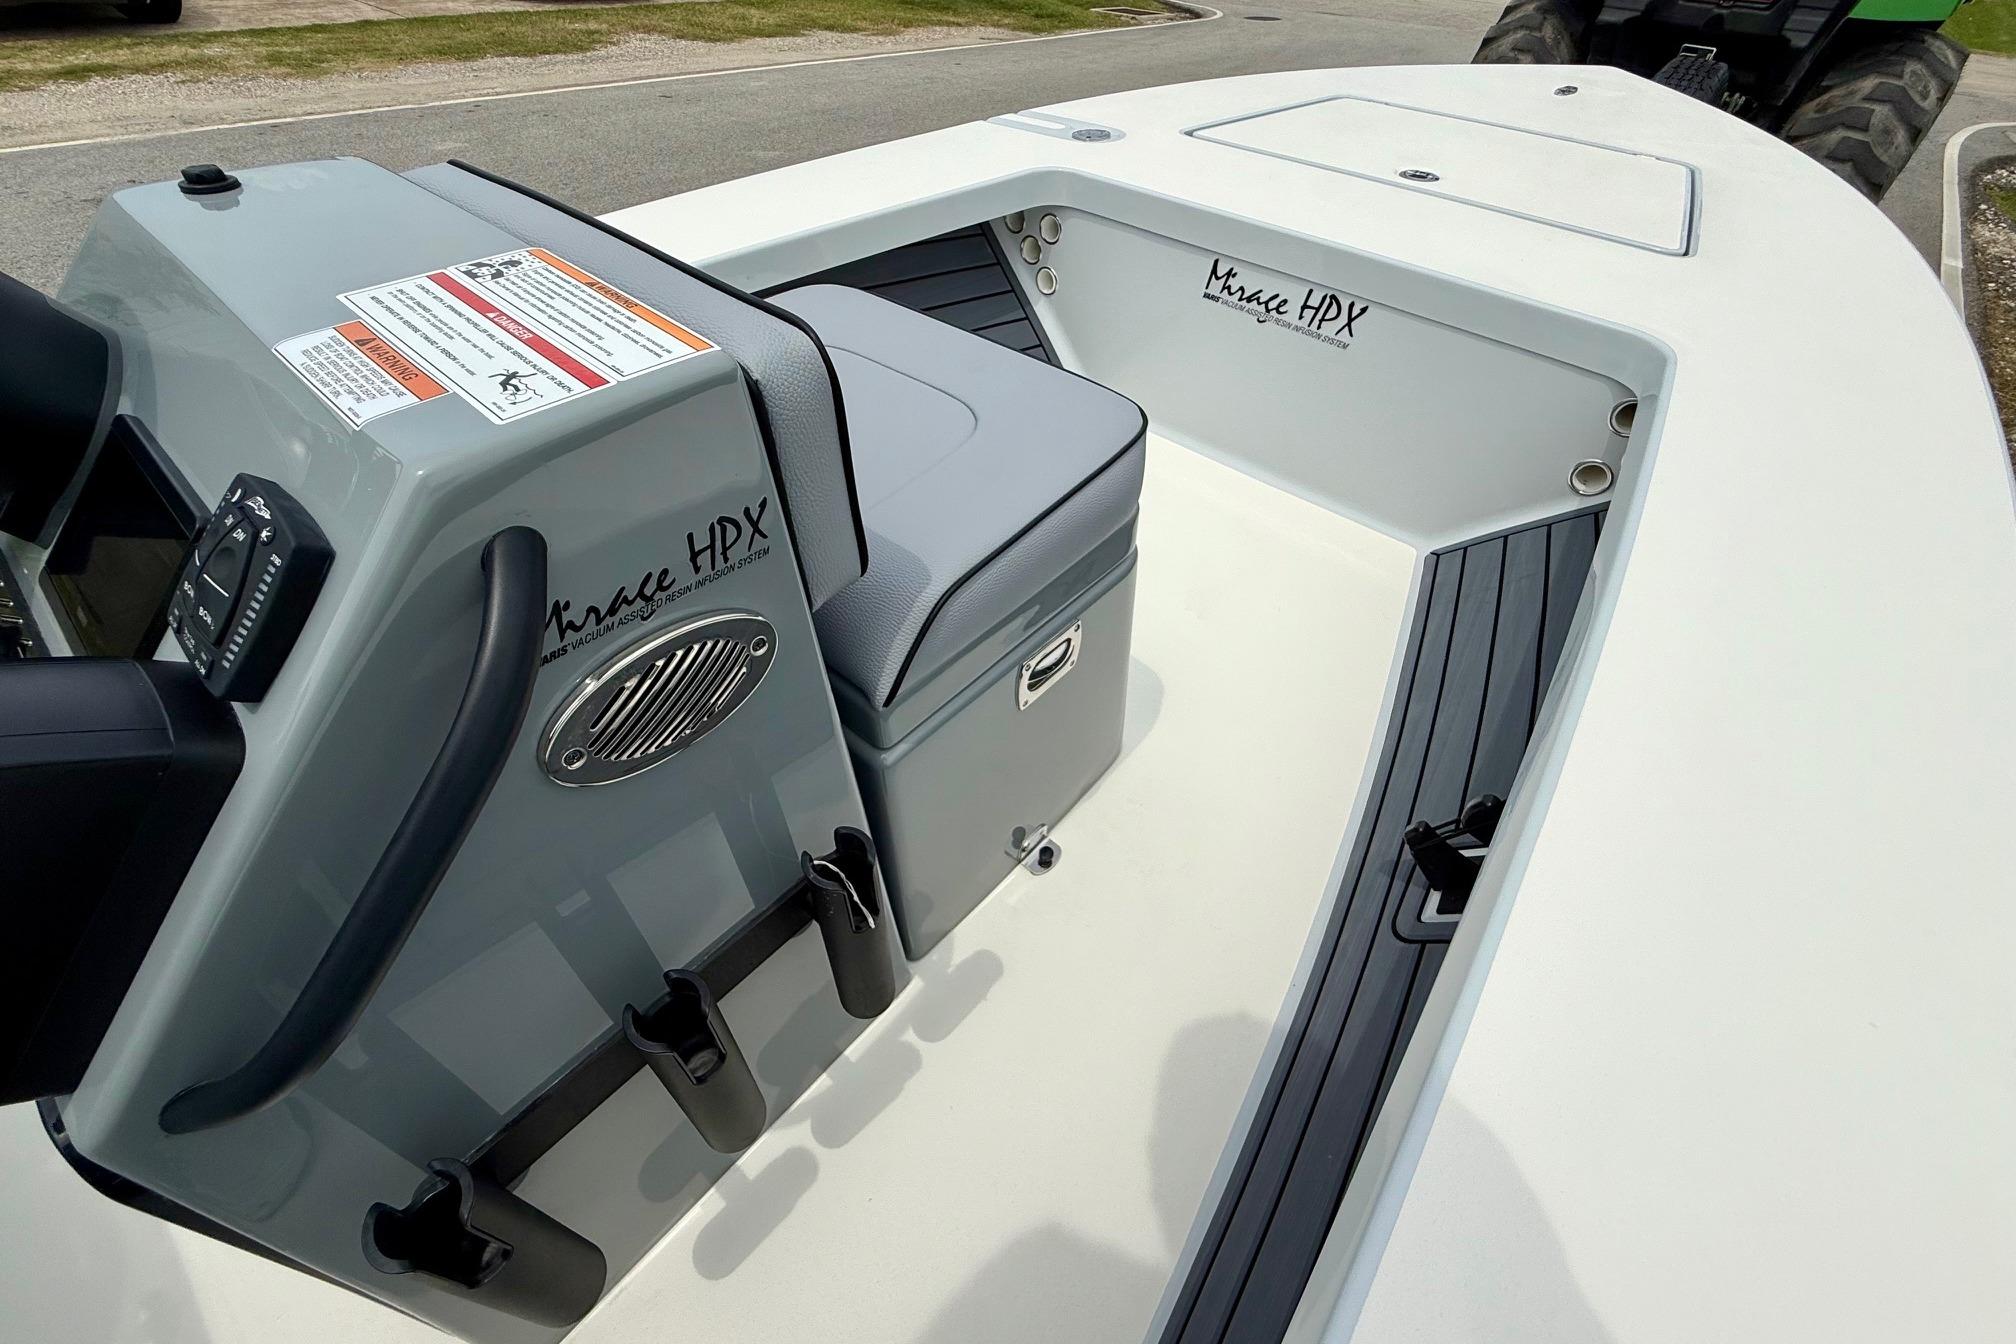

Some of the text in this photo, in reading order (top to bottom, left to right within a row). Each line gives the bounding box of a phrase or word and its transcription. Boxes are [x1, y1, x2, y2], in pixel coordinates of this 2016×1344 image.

[593, 285, 638, 308] WARNING
[1205, 258, 1369, 337] Mirage HPX
[492, 315, 534, 339] DANGER
[1221, 298, 1245, 312] VACUUM
[1245, 306, 1273, 322] ASSISTED
[1273, 317, 1292, 331] RESIN
[1292, 324, 1321, 341] INFUSION
[1322, 335, 1349, 350] SYSTEM
[365, 344, 419, 380] WARNING
[232, 528, 247, 541] DN
[686, 496, 768, 575] HPX
[541, 546, 770, 666] ARIS VACUUM ASSISTED RESIN INFUSION SYSTEM
